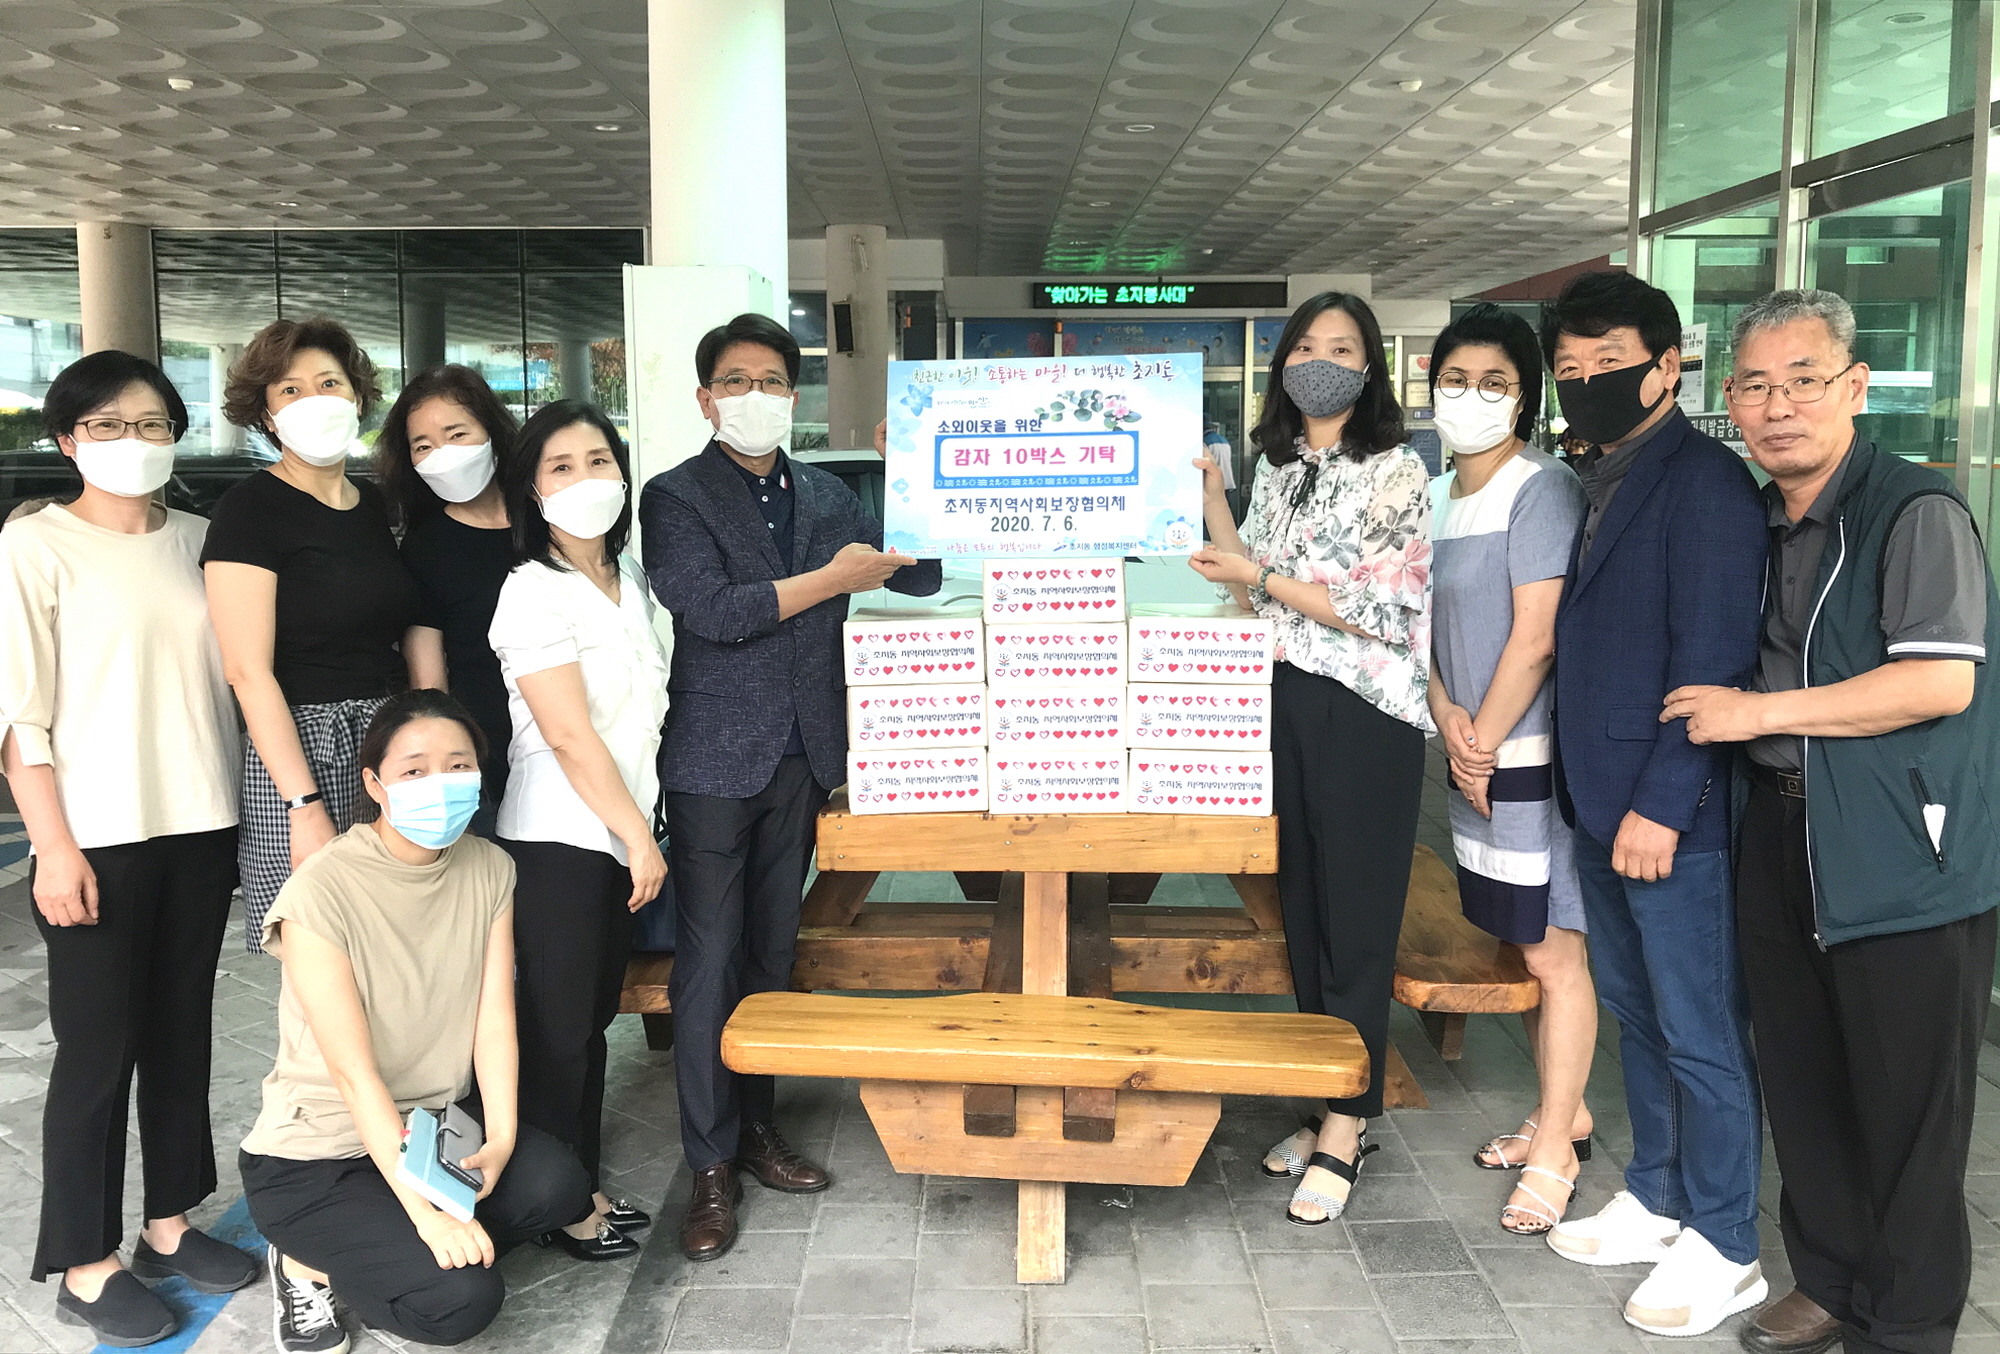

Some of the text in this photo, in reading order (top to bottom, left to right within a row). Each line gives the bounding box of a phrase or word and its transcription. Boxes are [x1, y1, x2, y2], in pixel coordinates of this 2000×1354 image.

[914, 369, 944, 383] 친근한
[988, 366, 1027, 384] 소통하는
[1035, 363, 1067, 383] 마을!
[1074, 367, 1085, 376] 더
[1091, 363, 1126, 380] 행복한
[1133, 360, 1175, 381] 초지동
[937, 418, 1042, 434] 소외이웃을 위한
[954, 445, 1116, 466] 감자 10박스 기탁
[944, 496, 1126, 514] 초지동지역사회보장협의체
[990, 515, 1078, 532] 2020. 7. 6.
[1069, 542, 1138, 551] 초지동 행정복지센터
